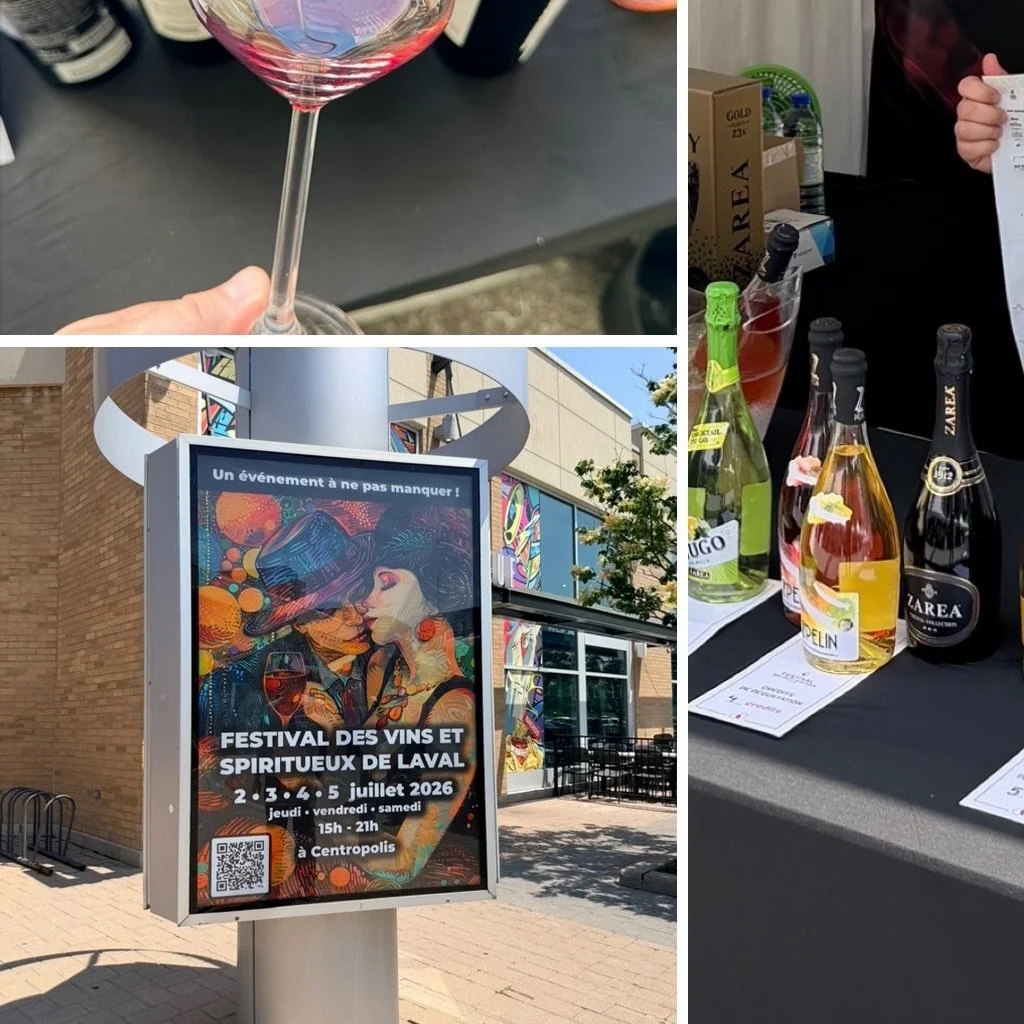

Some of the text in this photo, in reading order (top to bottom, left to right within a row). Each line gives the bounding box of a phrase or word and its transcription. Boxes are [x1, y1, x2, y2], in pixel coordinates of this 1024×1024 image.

[726, 107, 752, 122] GOLD
[944, 385, 957, 436] ZAREA
[213, 468, 234, 481] Un
[238, 471, 324, 488] événement
[328, 478, 337, 489] à
[341, 480, 359, 490] ne
[363, 482, 387, 493] pas
[391, 485, 452, 497] manquer
[688, 536, 726, 558] UGO
[907, 593, 962, 619] ZAREA
[220, 728, 464, 749] FESTIVAL DES VINS ET
[219, 752, 465, 775] SPIRITUEUX DE LAVAL
[234, 781, 453, 804] 2 3 4 5 juillet 2026
[1006, 786, 1024, 796] 5
[268, 801, 421, 821] jeudi vendredi samedi
[319, 821, 342, 835] 15h
[356, 820, 379, 833] 21h
[297, 841, 396, 858] à Centropolis
